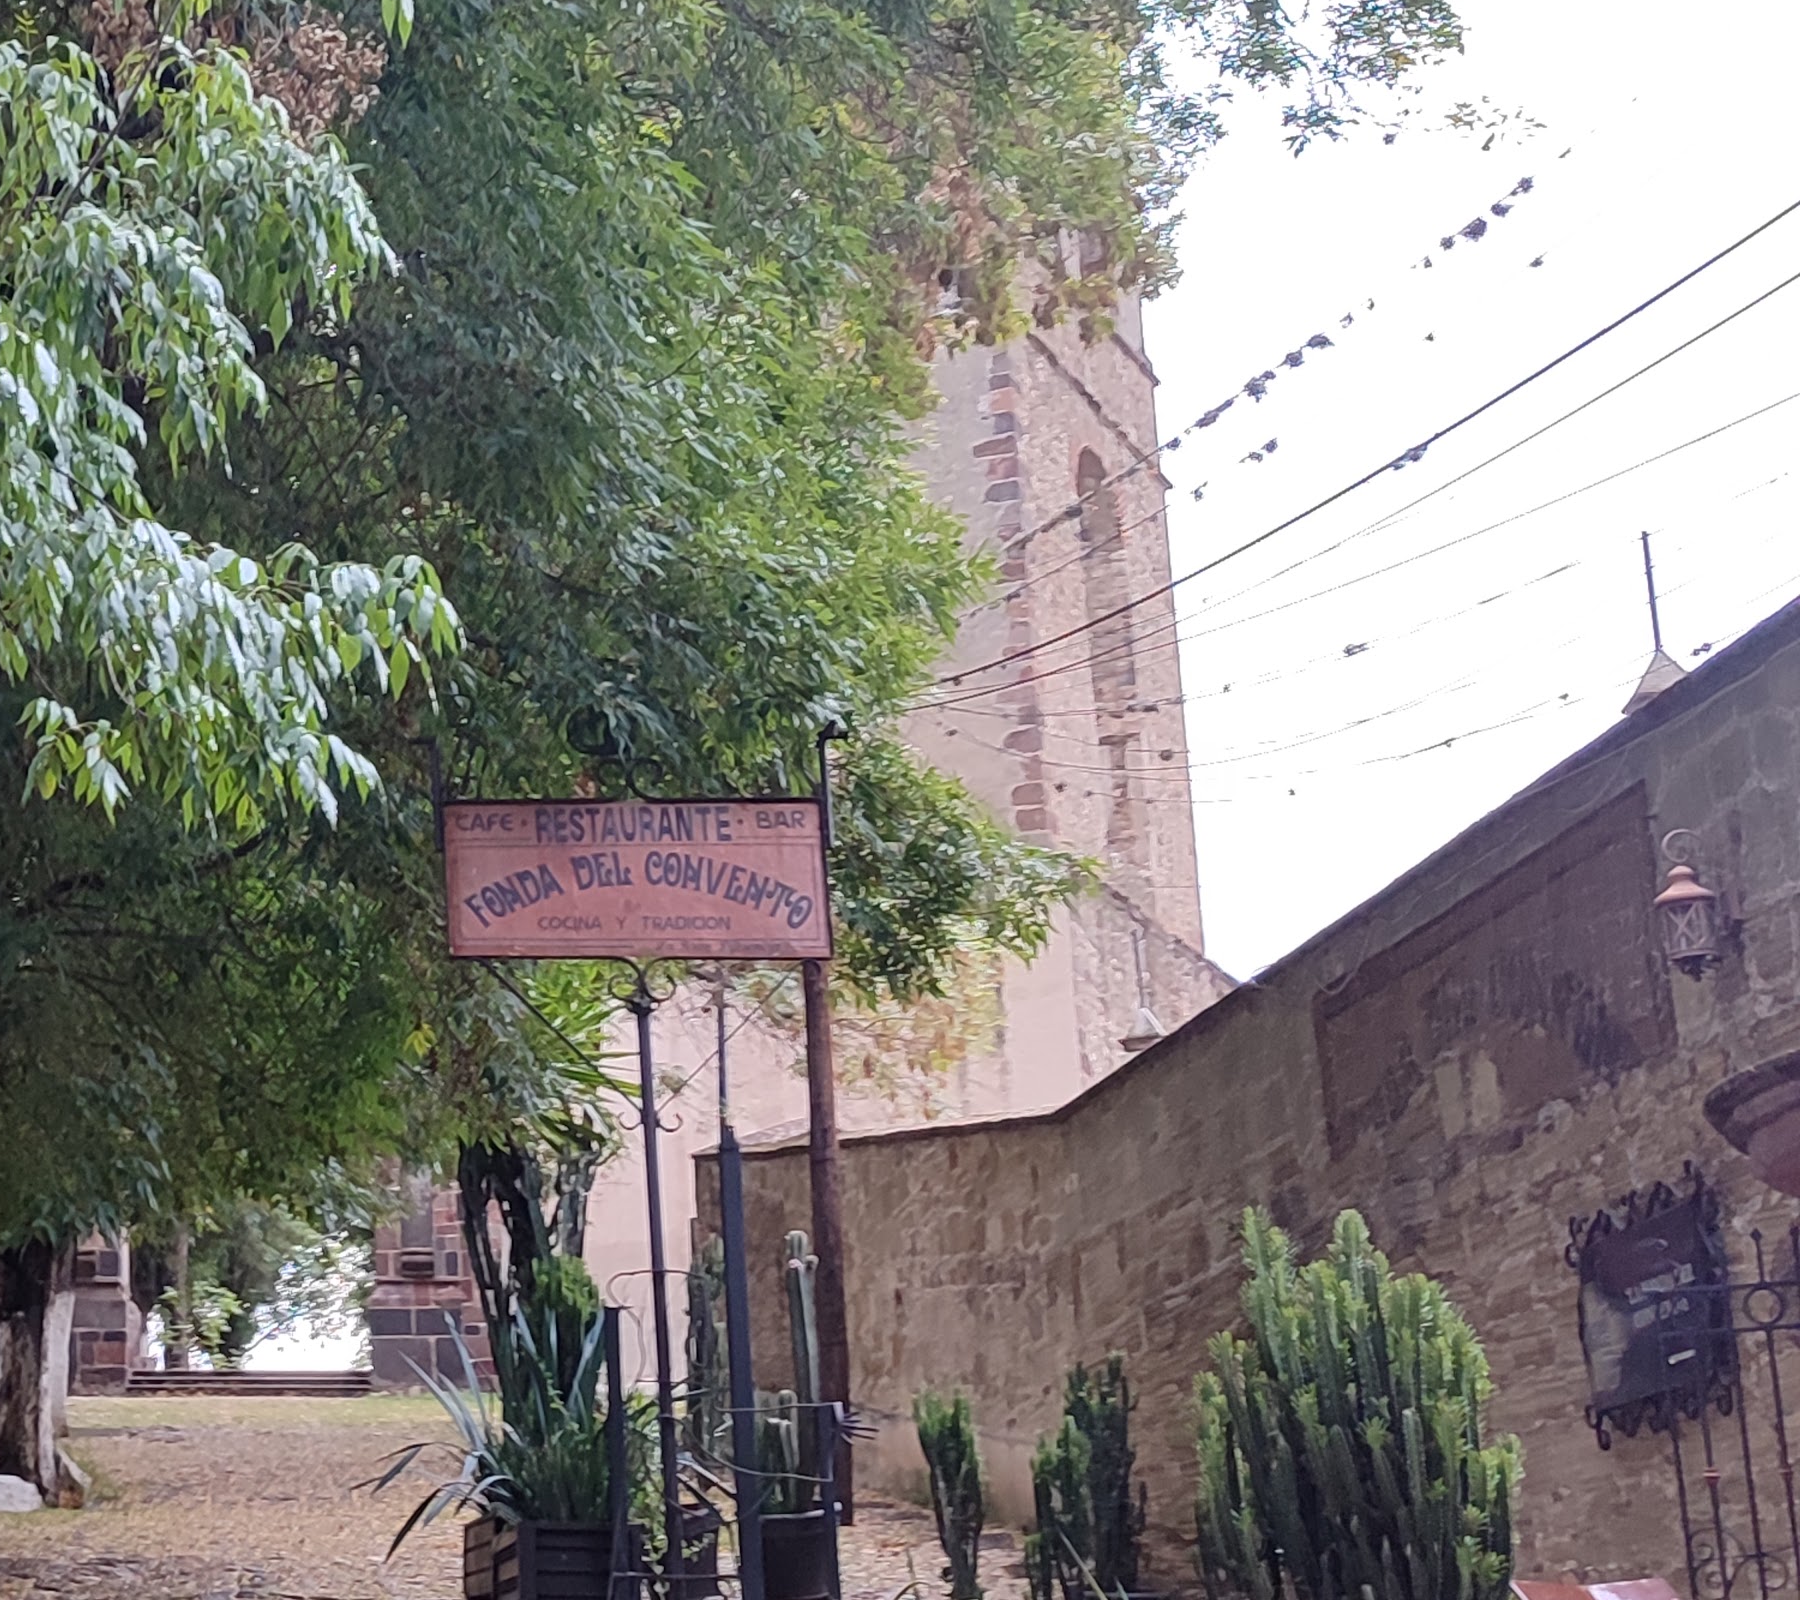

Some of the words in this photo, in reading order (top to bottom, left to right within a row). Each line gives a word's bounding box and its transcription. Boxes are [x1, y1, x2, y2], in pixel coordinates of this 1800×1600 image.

[455, 812, 514, 833] CAFE
[535, 805, 733, 844] RESTAURANTE
[756, 810, 806, 830] BAR
[464, 864, 564, 928] FONDA
[570, 851, 632, 891] DEL
[644, 851, 813, 930] CONVENTO
[537, 915, 602, 931] COCINA
[615, 916, 626, 931] Y
[641, 915, 732, 931] TRADICION
